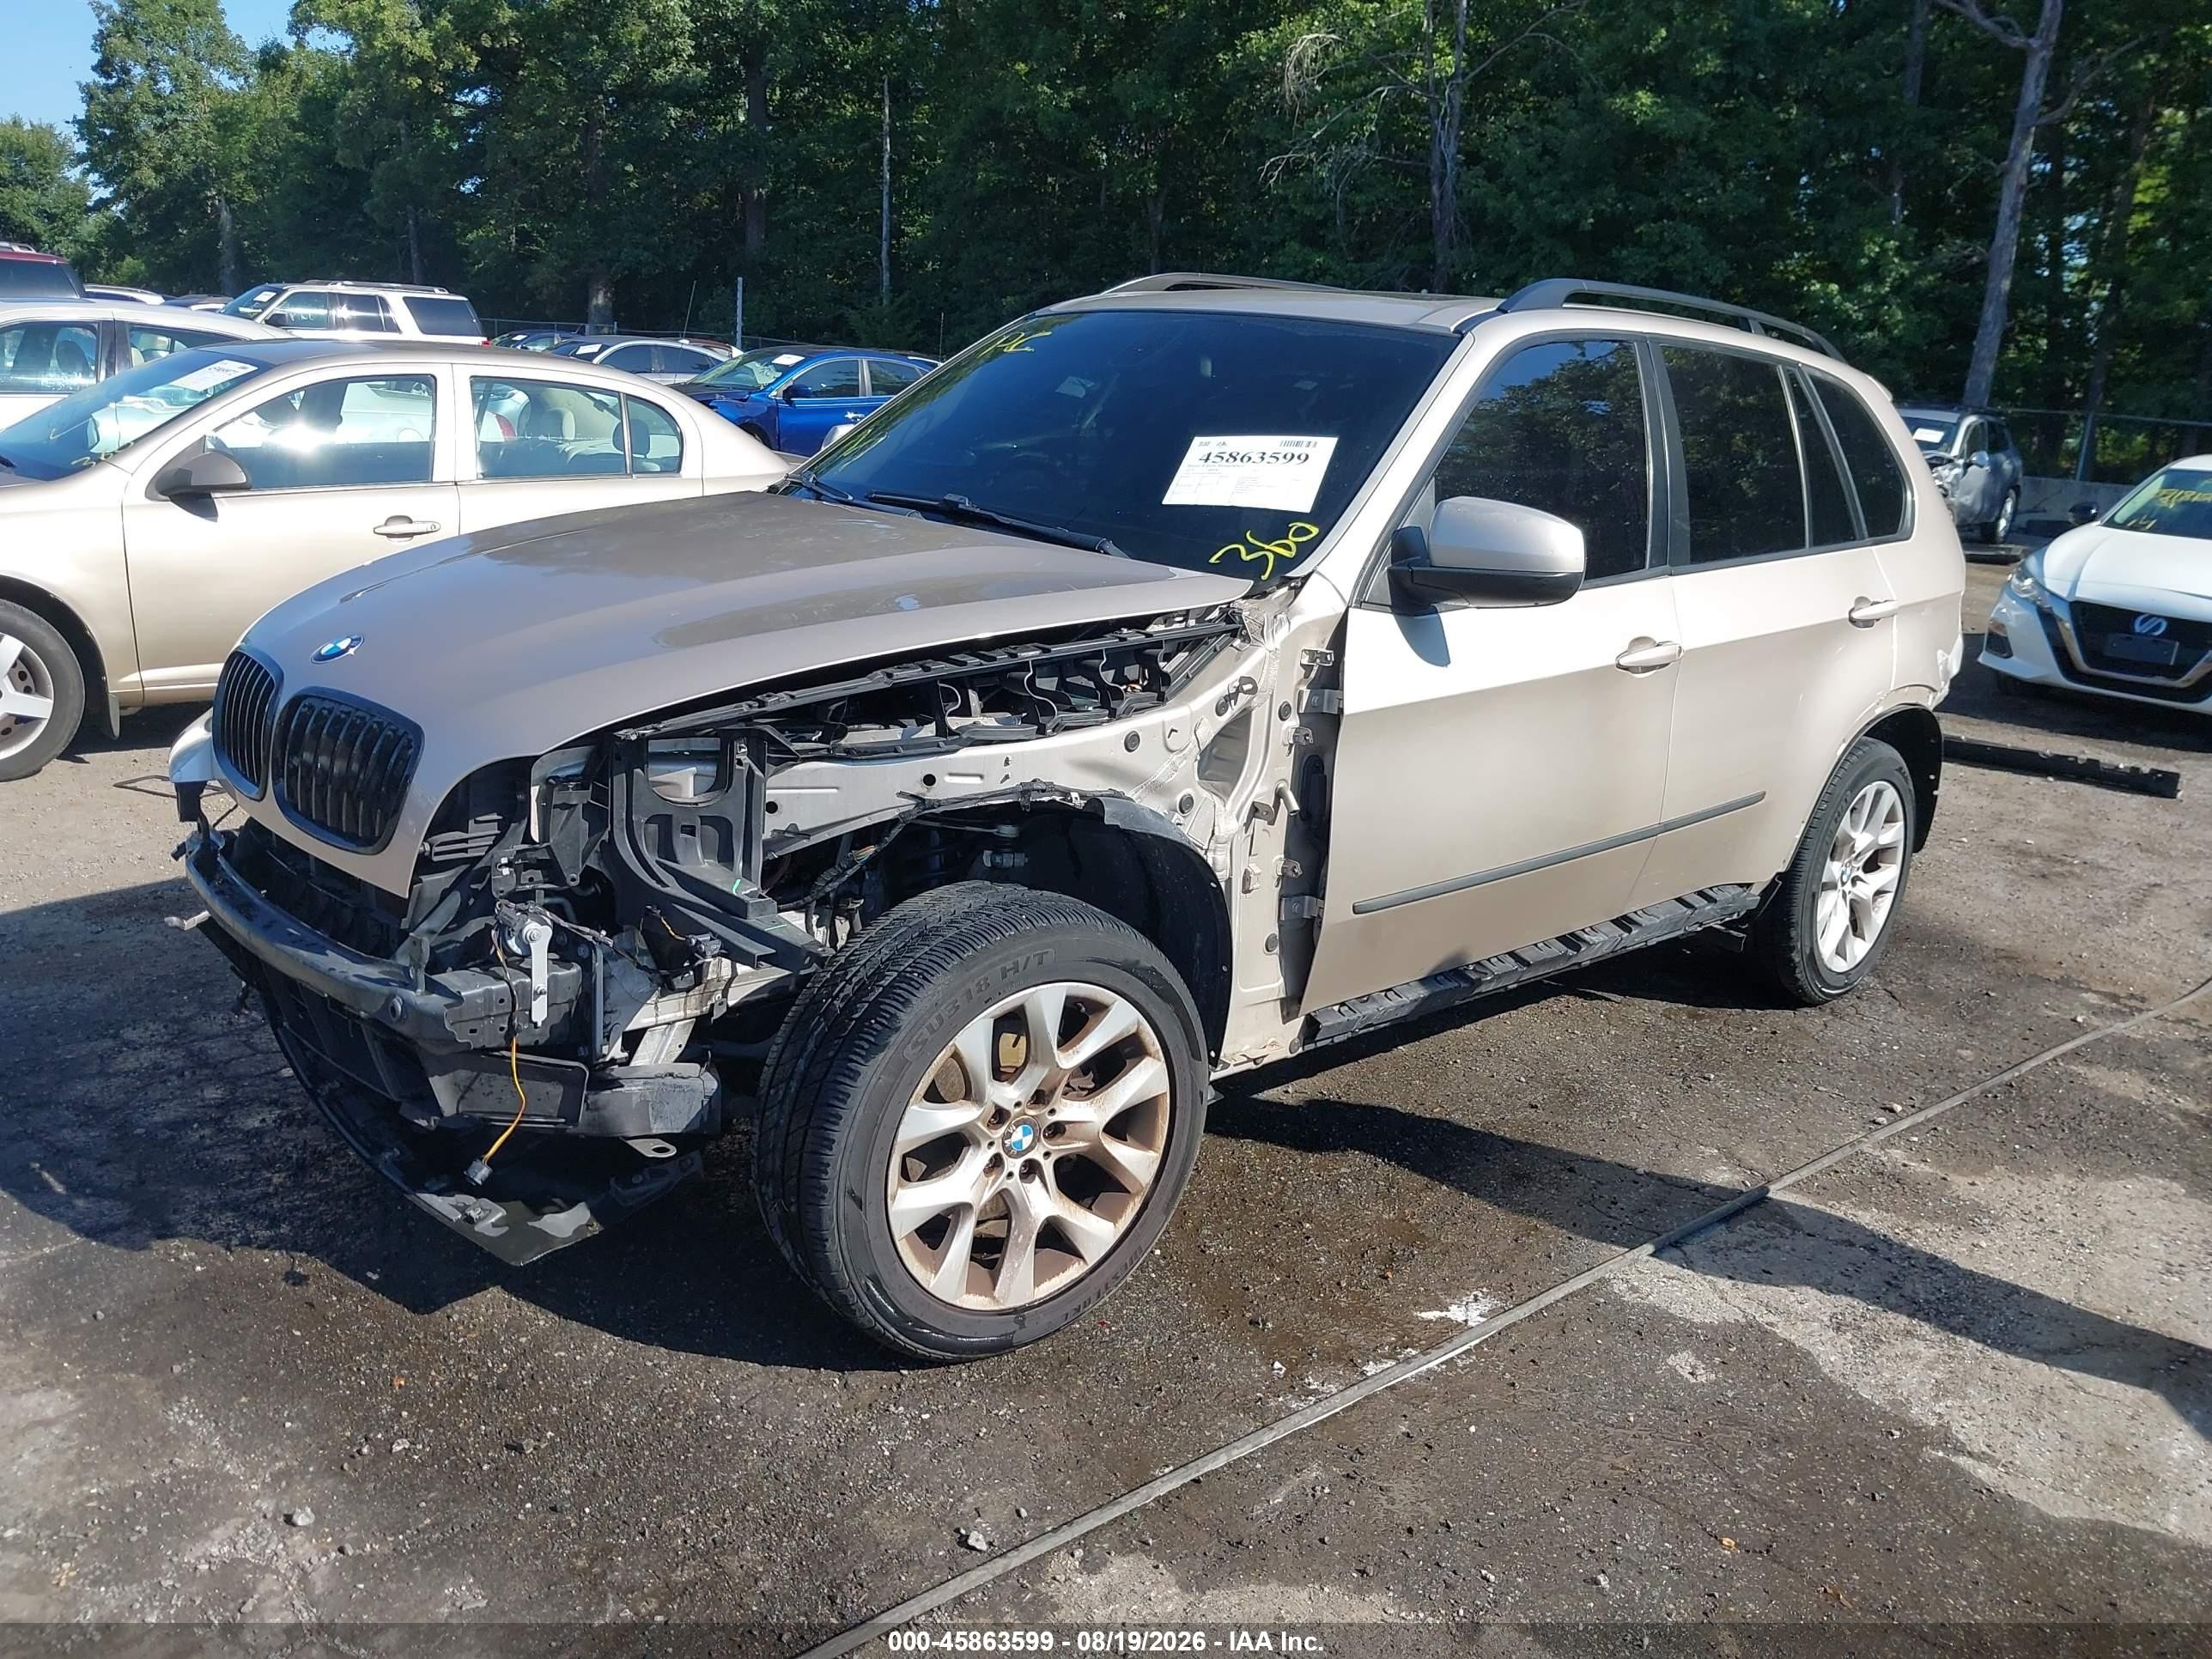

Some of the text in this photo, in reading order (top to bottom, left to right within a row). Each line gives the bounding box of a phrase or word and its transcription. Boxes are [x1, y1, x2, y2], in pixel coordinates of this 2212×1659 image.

[1199, 451, 1310, 465] 45863599
[909, 975, 991, 1053] SU318
[1000, 950, 1050, 980] H/T
